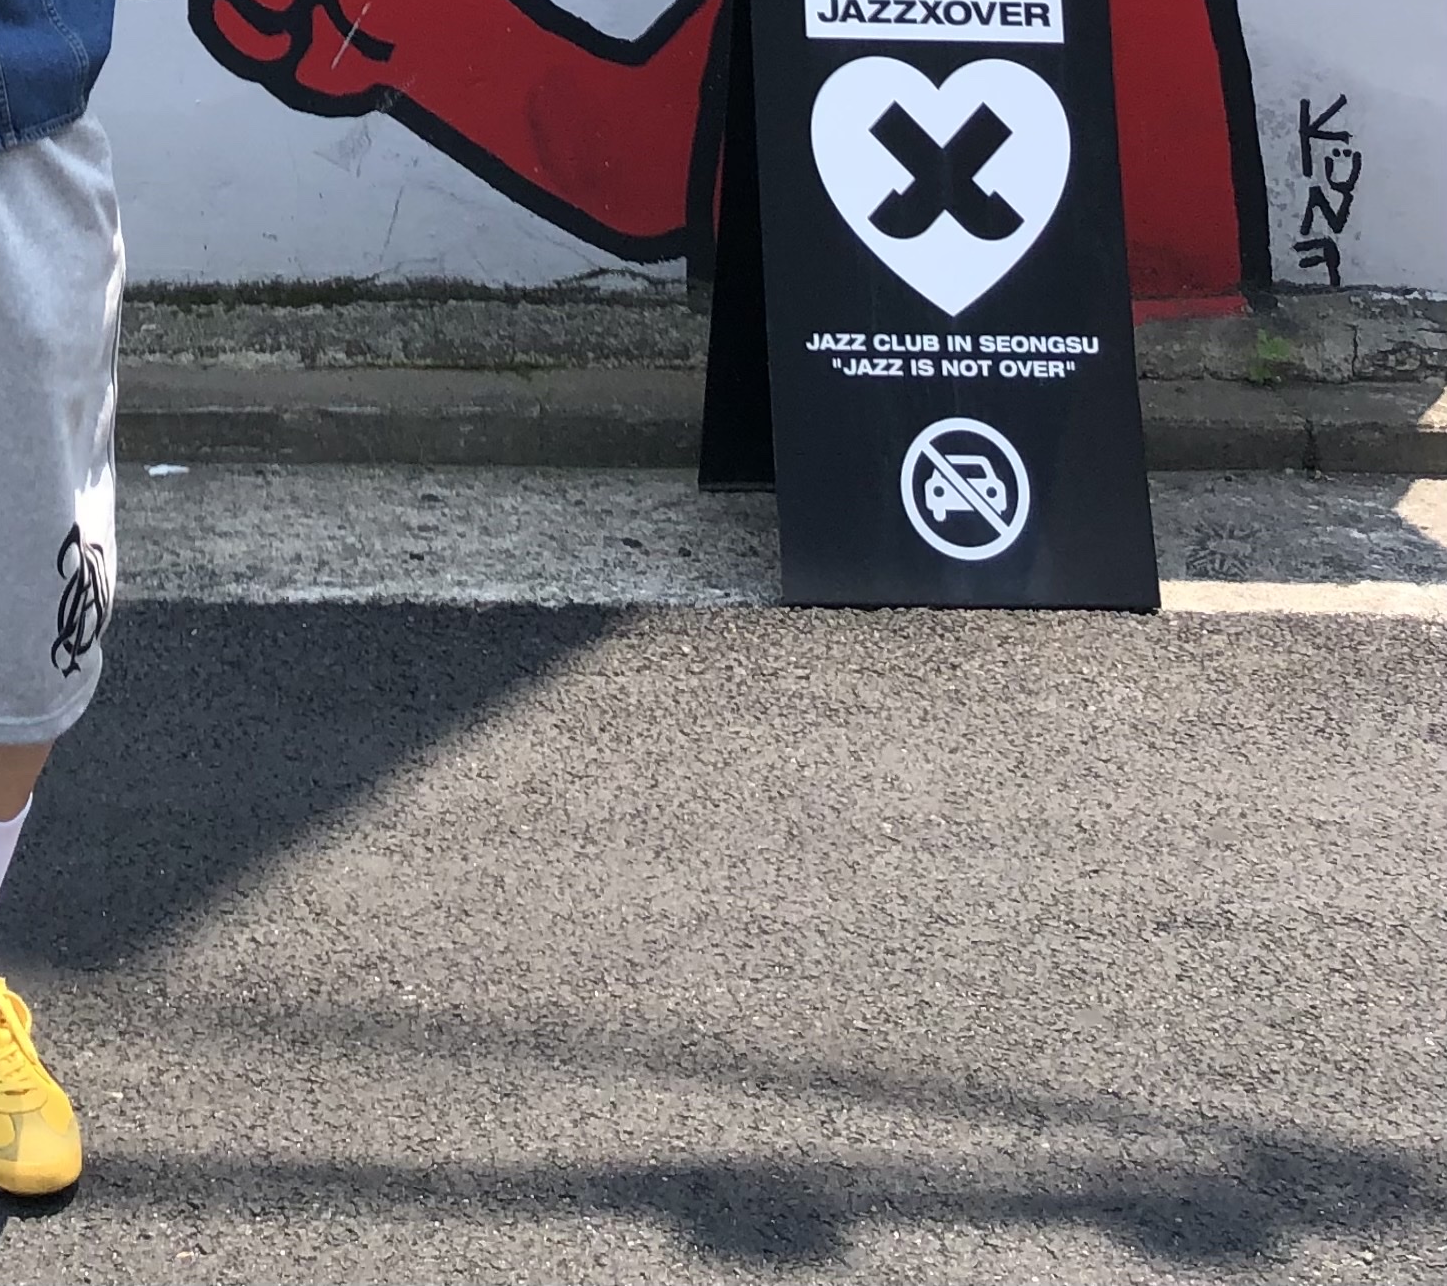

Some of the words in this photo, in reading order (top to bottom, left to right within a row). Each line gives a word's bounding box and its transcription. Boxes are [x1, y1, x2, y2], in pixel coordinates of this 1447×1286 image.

[806, 333, 866, 351] JAZZ
[873, 334, 940, 352] CLUB
[947, 335, 972, 352] IN
[979, 335, 1099, 354] SEONGSU
[832, 358, 903, 376] "JAZZ
[910, 359, 934, 377] IS
[941, 359, 992, 377] NOT
[999, 360, 1076, 378] OVER"
